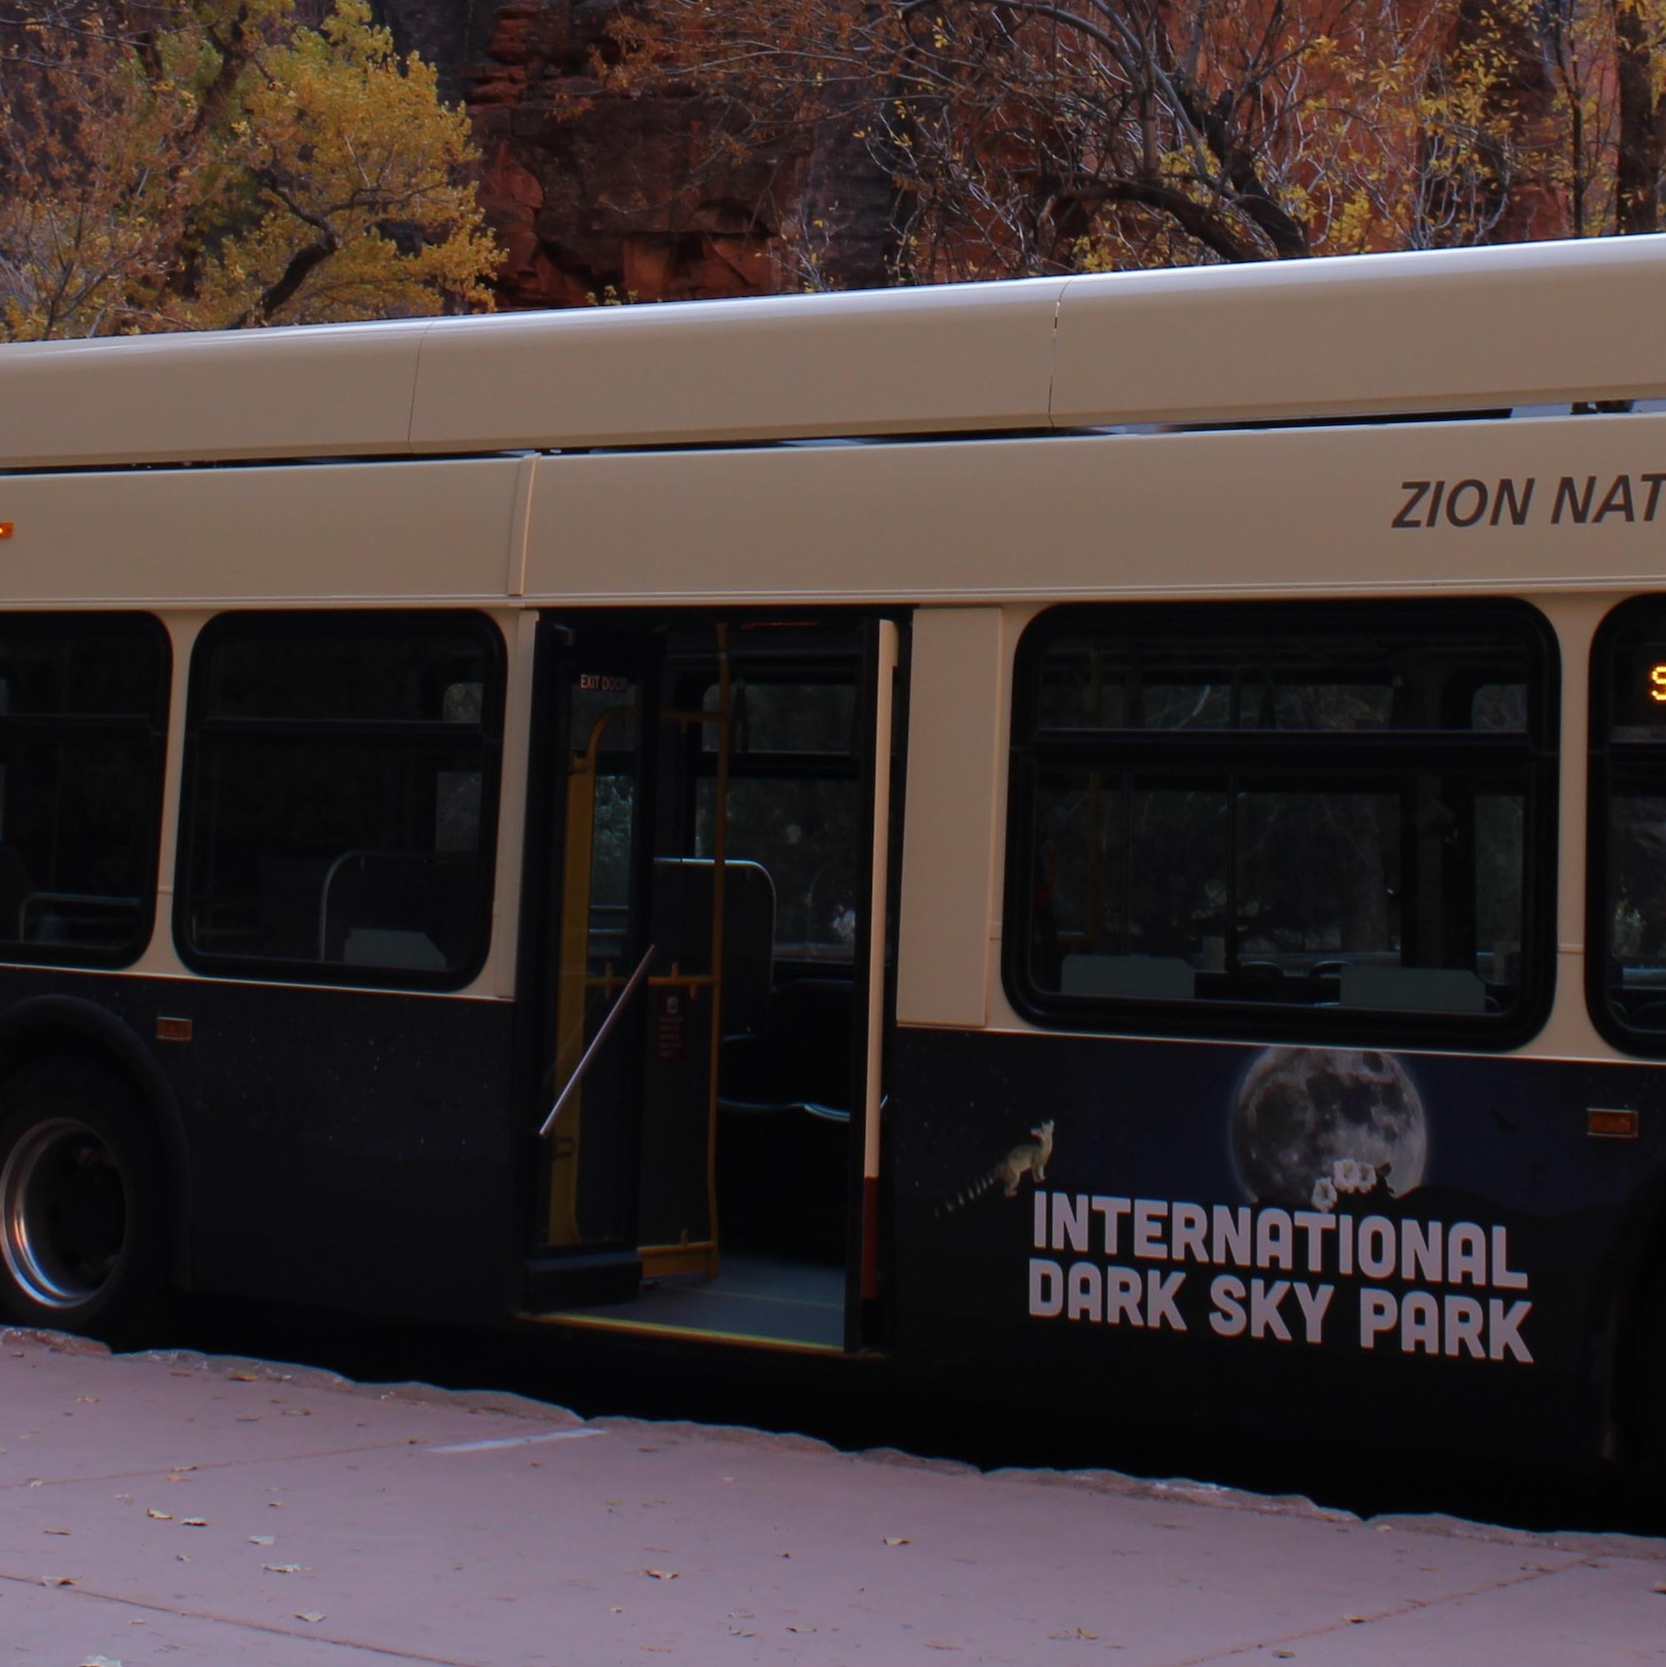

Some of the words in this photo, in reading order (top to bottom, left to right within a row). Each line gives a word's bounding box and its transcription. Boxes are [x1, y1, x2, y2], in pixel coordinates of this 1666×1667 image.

[1391, 477, 1536, 529] ZION
[580, 673, 600, 690] EXIT
[1033, 1190, 1528, 1289] INTERNATIONAL
[1028, 1258, 1188, 1331] DARK
[1208, 1274, 1335, 1344] SKY
[1359, 1287, 1534, 1363] PARK
